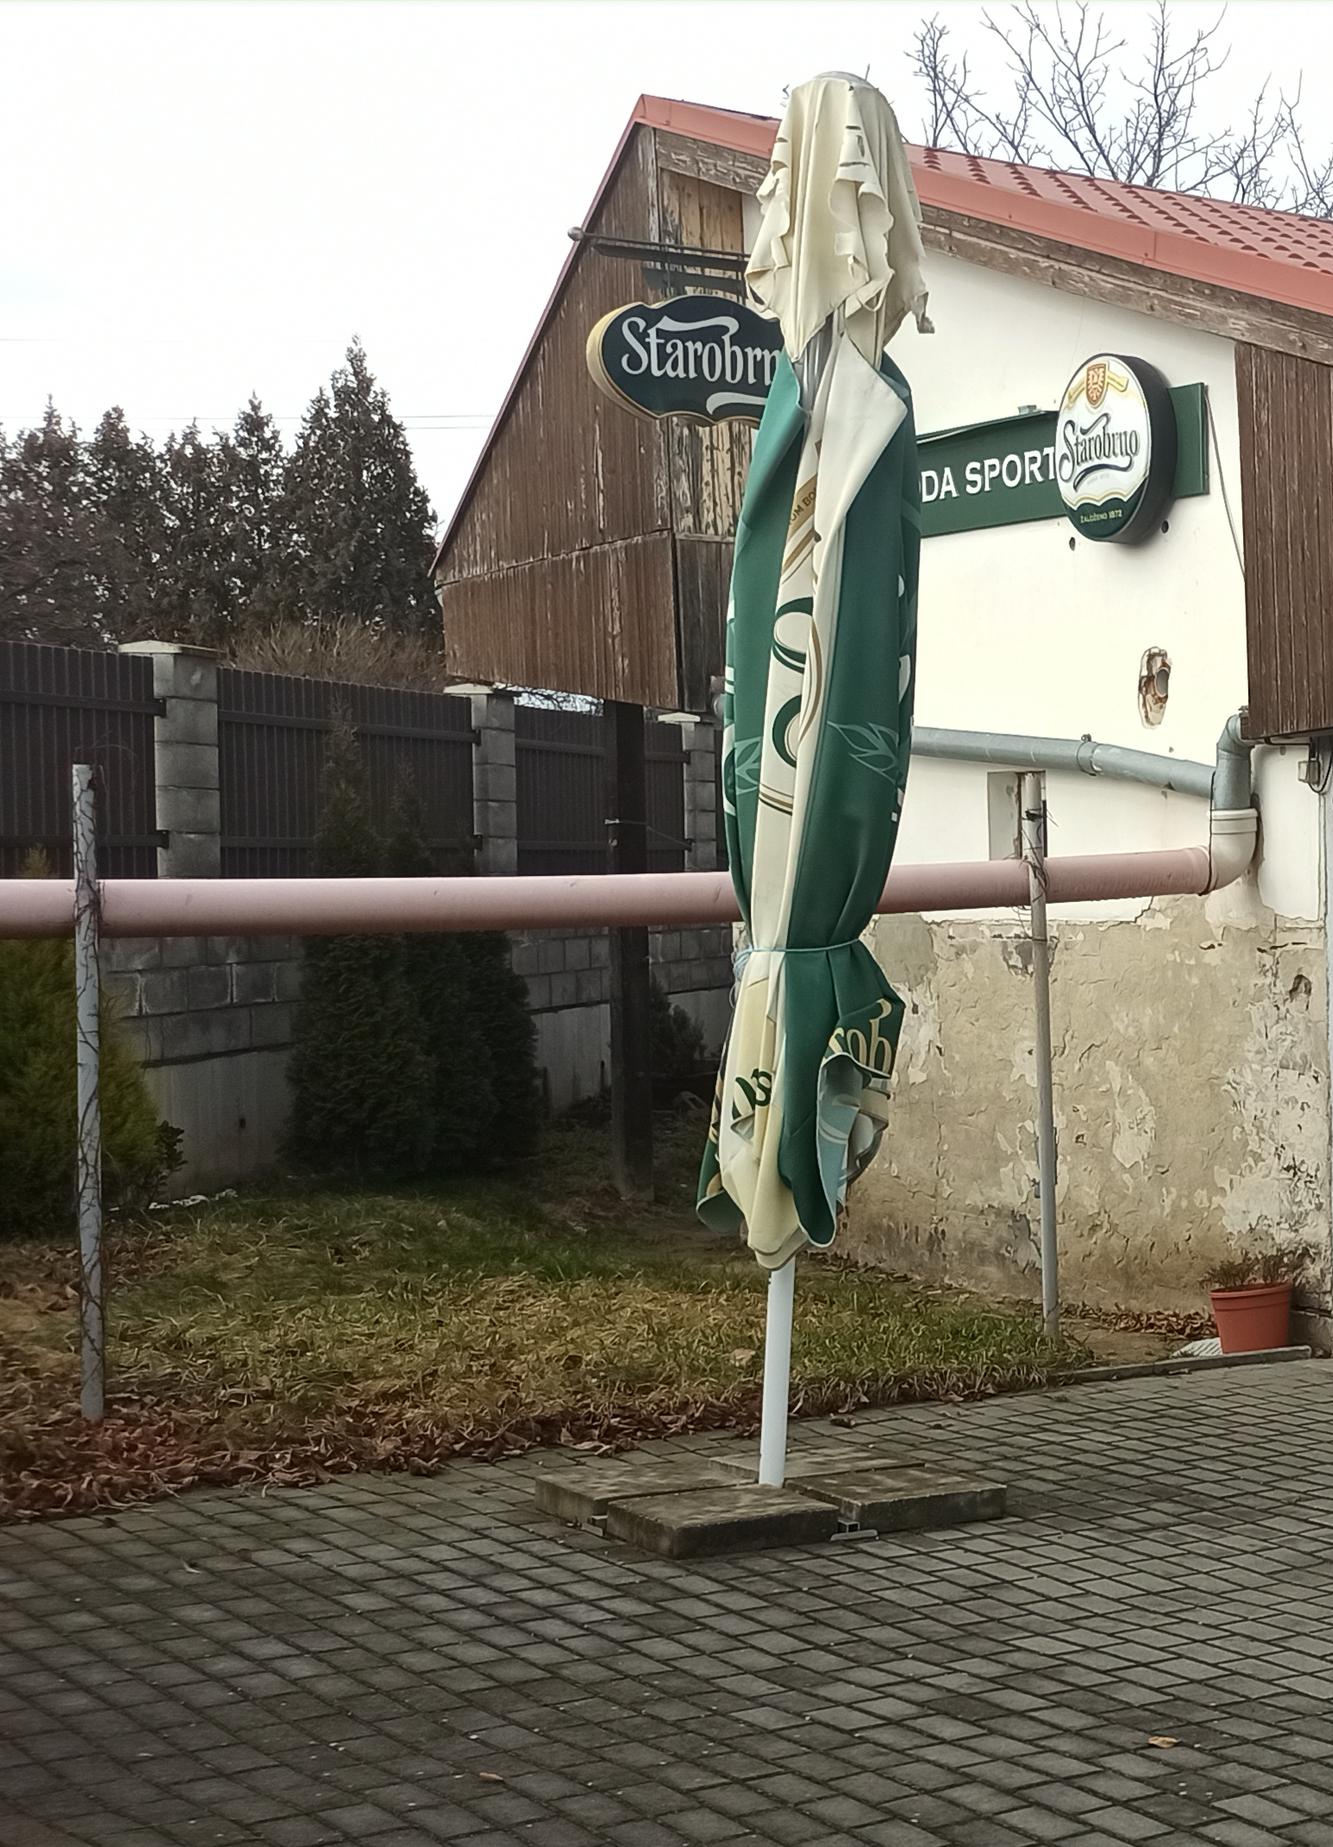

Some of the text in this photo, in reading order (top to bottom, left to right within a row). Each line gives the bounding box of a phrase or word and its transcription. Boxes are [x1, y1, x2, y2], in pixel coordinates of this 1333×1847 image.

[621, 315, 781, 387] Starobrn
[918, 446, 1055, 502] DA SPORT
[1058, 412, 1141, 485] Starobrno
